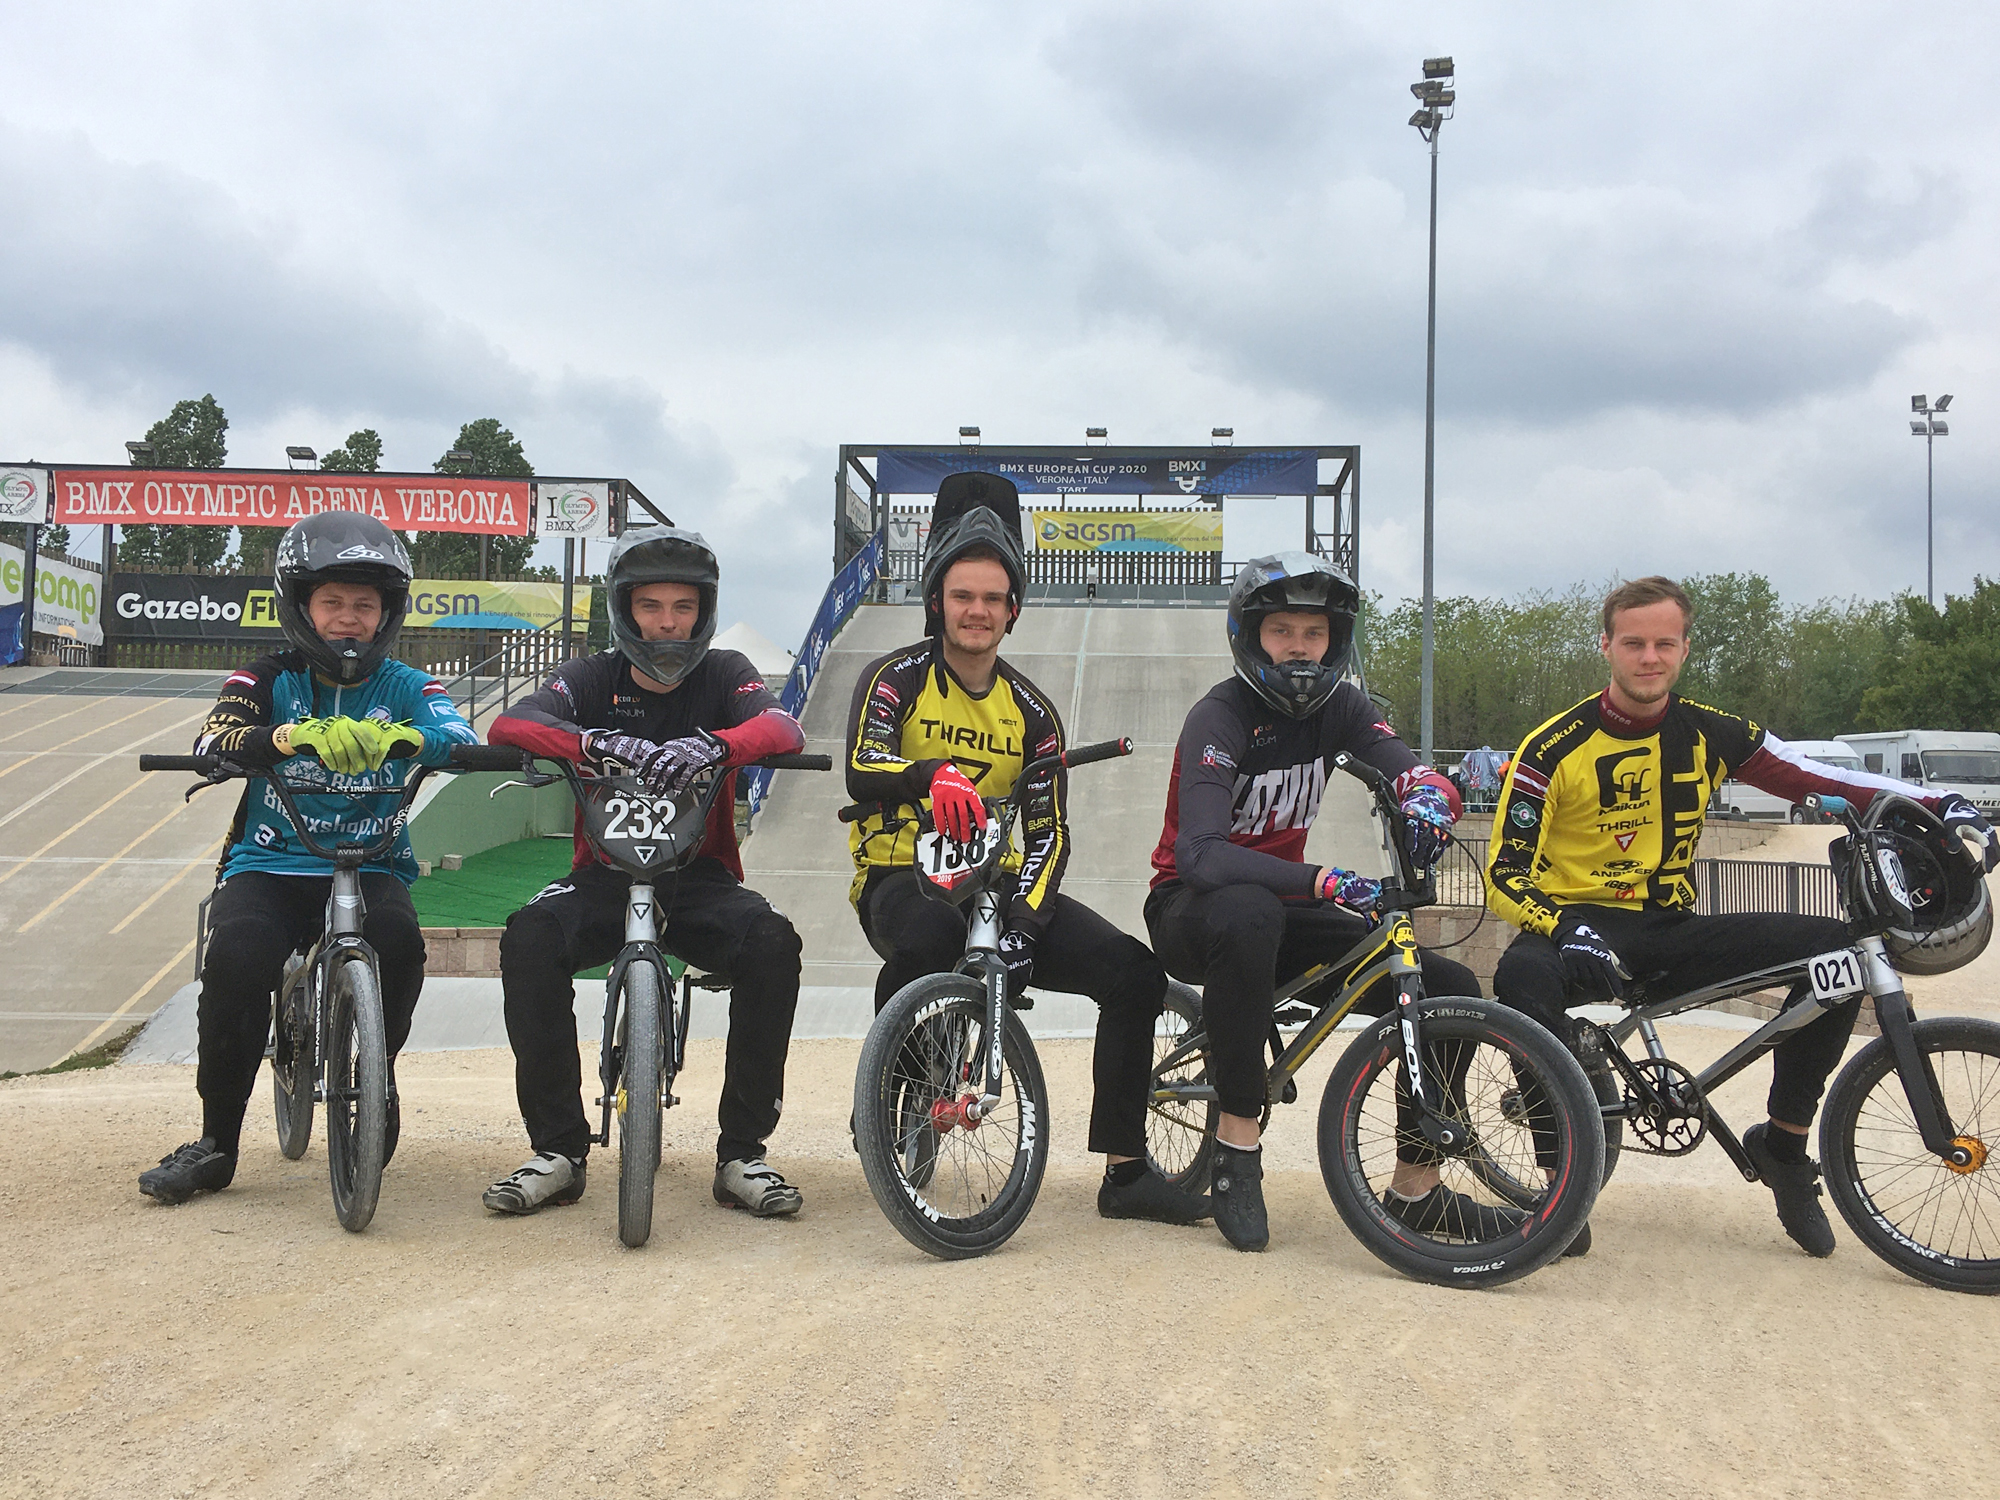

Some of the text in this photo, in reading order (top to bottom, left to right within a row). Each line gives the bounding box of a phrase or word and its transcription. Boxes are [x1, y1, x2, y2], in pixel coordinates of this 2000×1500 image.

[999, 463, 1147, 474] BMX EUROPEAN CUP 2020
[1168, 460, 1201, 472] BMX
[1035, 475, 1076, 484] VERONA
[1084, 476, 1109, 484] ITALY
[65, 481, 136, 515] BMX
[144, 481, 277, 519] OLYMPIC
[283, 485, 390, 522] ARENA
[395, 488, 519, 526] VERONA
[546, 496, 558, 519] I
[545, 520, 576, 531] BMX
[116, 592, 242, 621] Gazebo
[919, 718, 1022, 758] THRILL
[1535, 718, 1584, 760] Maikun
[1597, 799, 1651, 816] Maikun
[604, 797, 677, 841] 232
[1596, 816, 1654, 833] THRILL
[337, 848, 364, 856] AVIAN
[936, 874, 952, 883] 2019
[1562, 941, 1613, 962] Maikun
[1007, 957, 1033, 971] aikun
[1814, 955, 1857, 992] 021
[993, 973, 1003, 1042] ANSWER
[1401, 1018, 1425, 1100] BOX
[1020, 1100, 1036, 1151] MAX
[1871, 1214, 1941, 1260] DEVIANT
[1452, 1264, 1491, 1274] TIOGA
